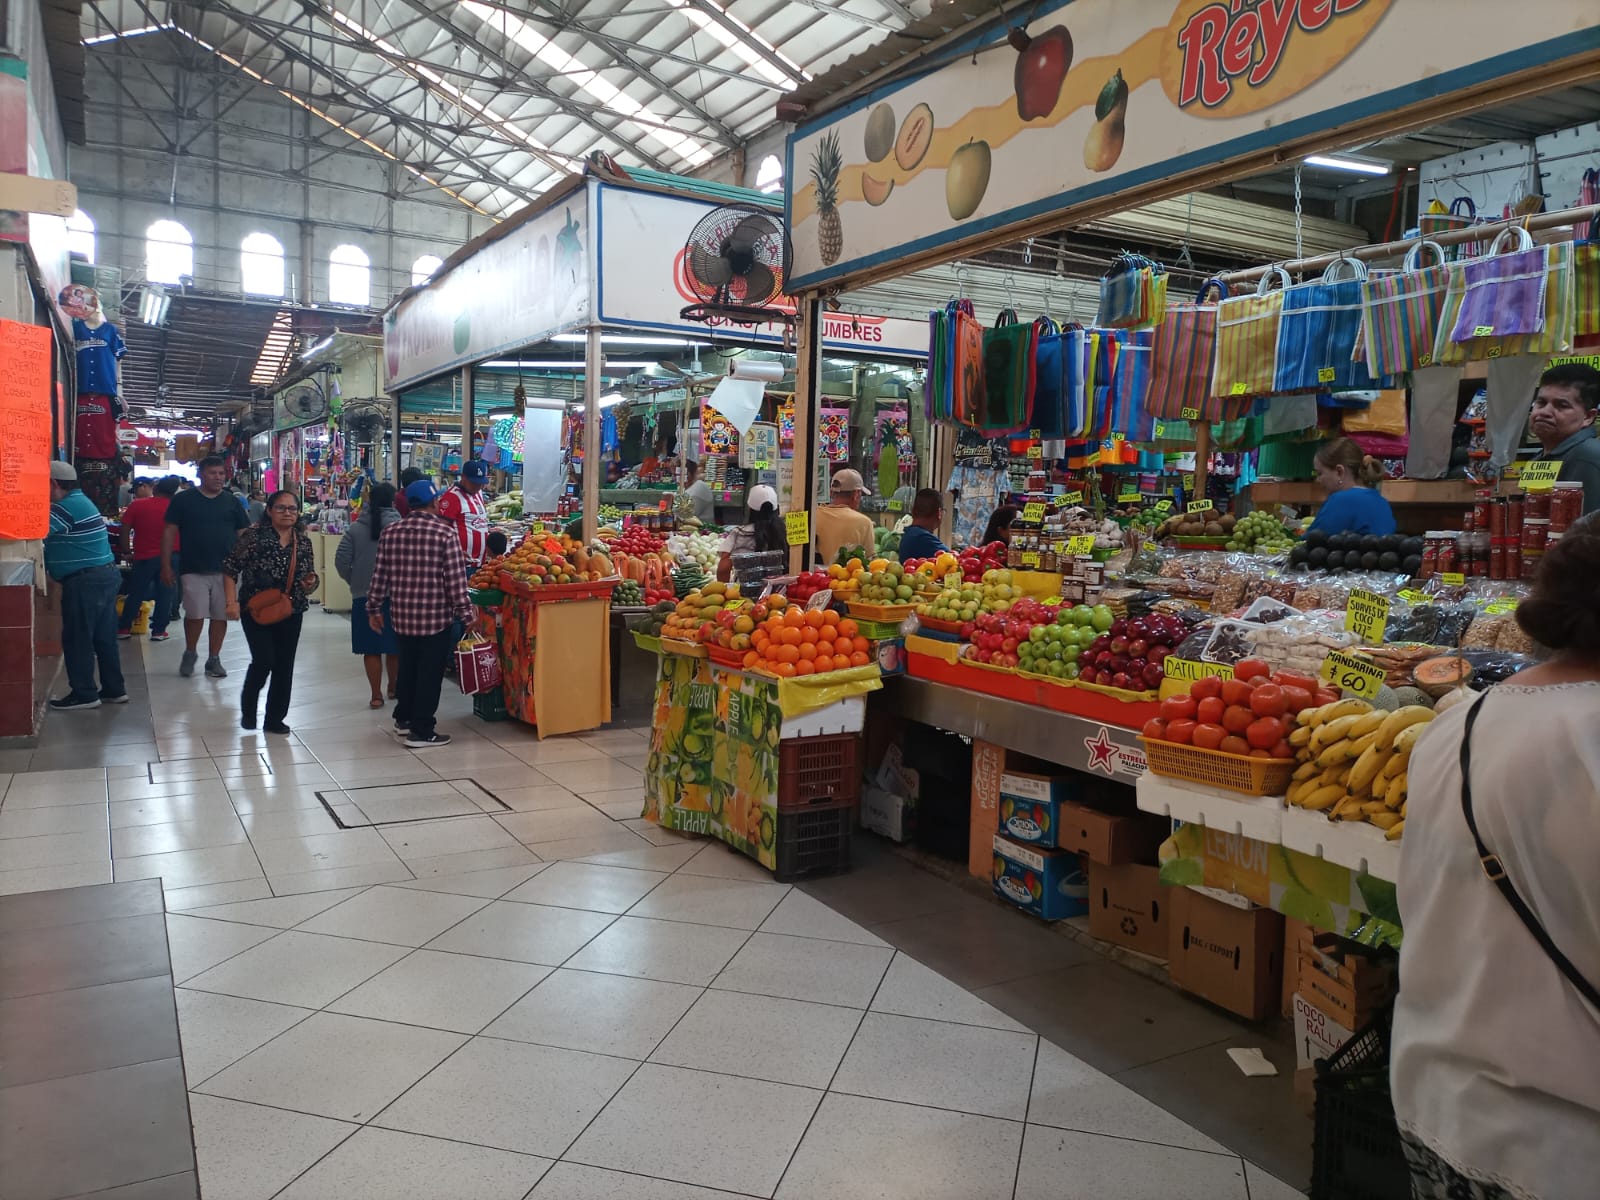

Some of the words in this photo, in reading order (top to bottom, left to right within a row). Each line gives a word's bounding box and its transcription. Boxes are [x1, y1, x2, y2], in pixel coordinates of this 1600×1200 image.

[1354, 611, 1373, 625] COCO
[1326, 651, 1384, 680] MANDARINA
[730, 692, 740, 737] APPLE
[1118, 752, 1148, 766] ESTRELL
[1206, 832, 1268, 875] LEMON
[1297, 999, 1325, 1026] COCO
[1306, 1018, 1345, 1051] RALLA
